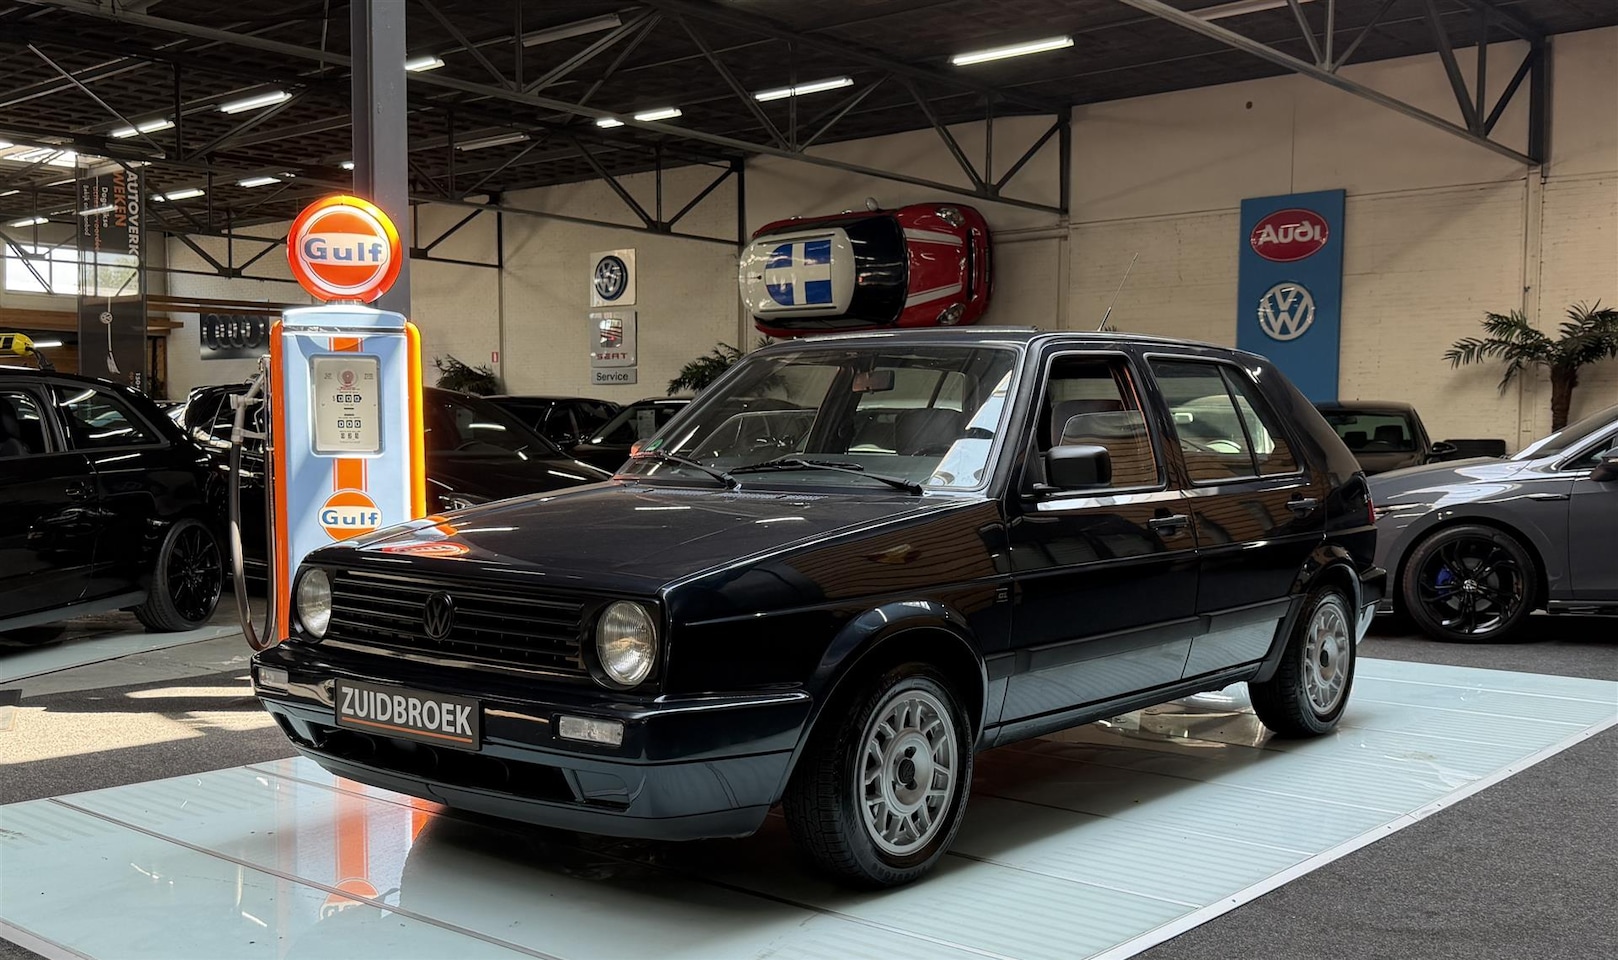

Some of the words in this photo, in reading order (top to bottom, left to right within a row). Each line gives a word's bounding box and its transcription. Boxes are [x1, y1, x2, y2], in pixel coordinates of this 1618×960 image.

[113, 170, 127, 227] WEKEN
[1257, 220, 1321, 245] Audi
[304, 237, 383, 262] Gulf
[597, 352, 627, 360] SEAT
[596, 371, 629, 381] Service
[321, 509, 379, 525] Gulf
[341, 686, 473, 736] ZUIDBROEK
